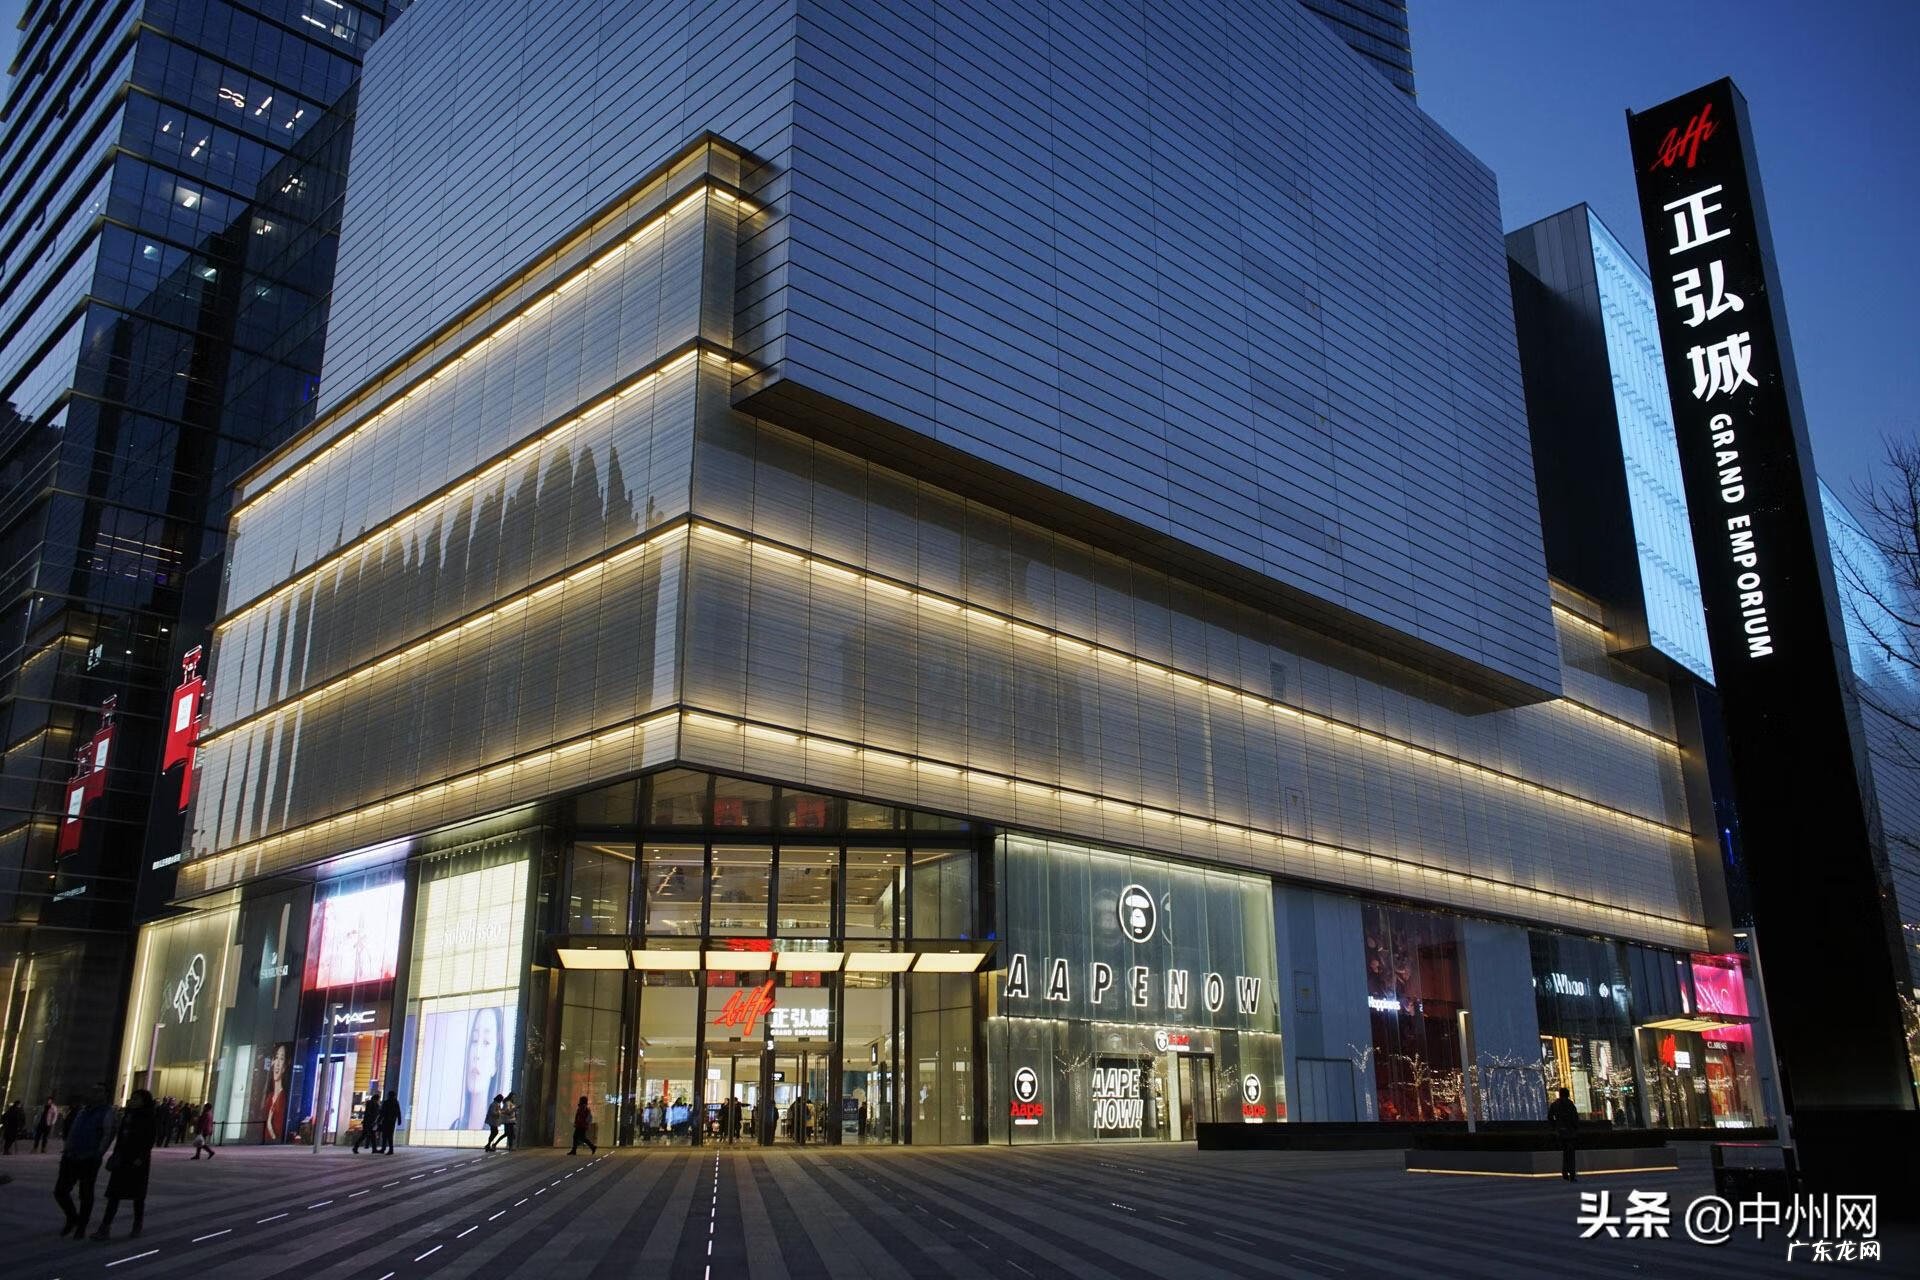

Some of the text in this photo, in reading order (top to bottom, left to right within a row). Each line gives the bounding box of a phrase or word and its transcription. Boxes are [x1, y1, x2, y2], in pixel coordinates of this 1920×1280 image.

[1662, 184, 1759, 403] 正弘城
[1709, 412, 1774, 658] GRAND EMPORIUM
[770, 1007, 829, 1029] 正弘城
[1092, 1067, 1142, 1098] AAPE
[1010, 1100, 1045, 1121] Aape
[1093, 1099, 1144, 1130] NOW!
